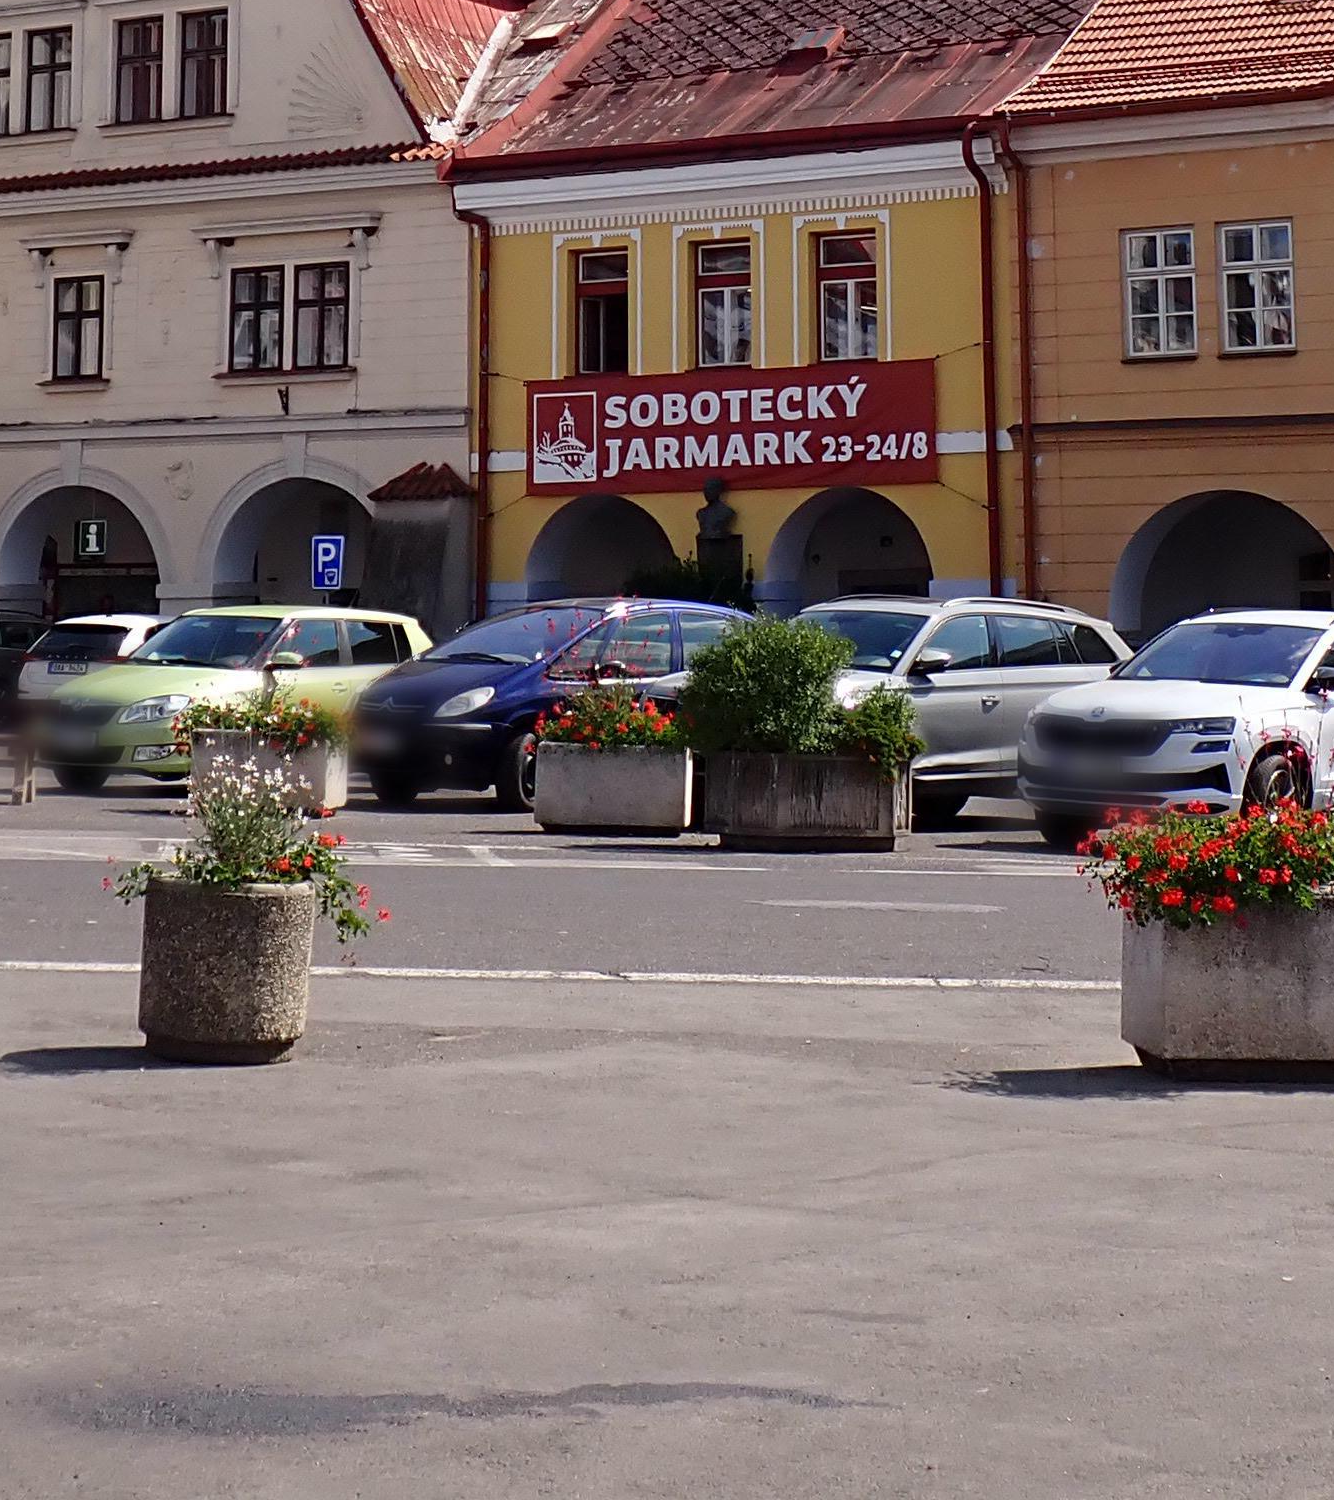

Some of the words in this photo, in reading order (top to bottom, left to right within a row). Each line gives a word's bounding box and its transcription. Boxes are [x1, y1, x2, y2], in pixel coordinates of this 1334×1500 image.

[603, 376, 867, 429] SOBOTECKÝ
[602, 430, 814, 479] JARMARK
[821, 431, 929, 463] 23-24/8
[318, 542, 336, 573] P
